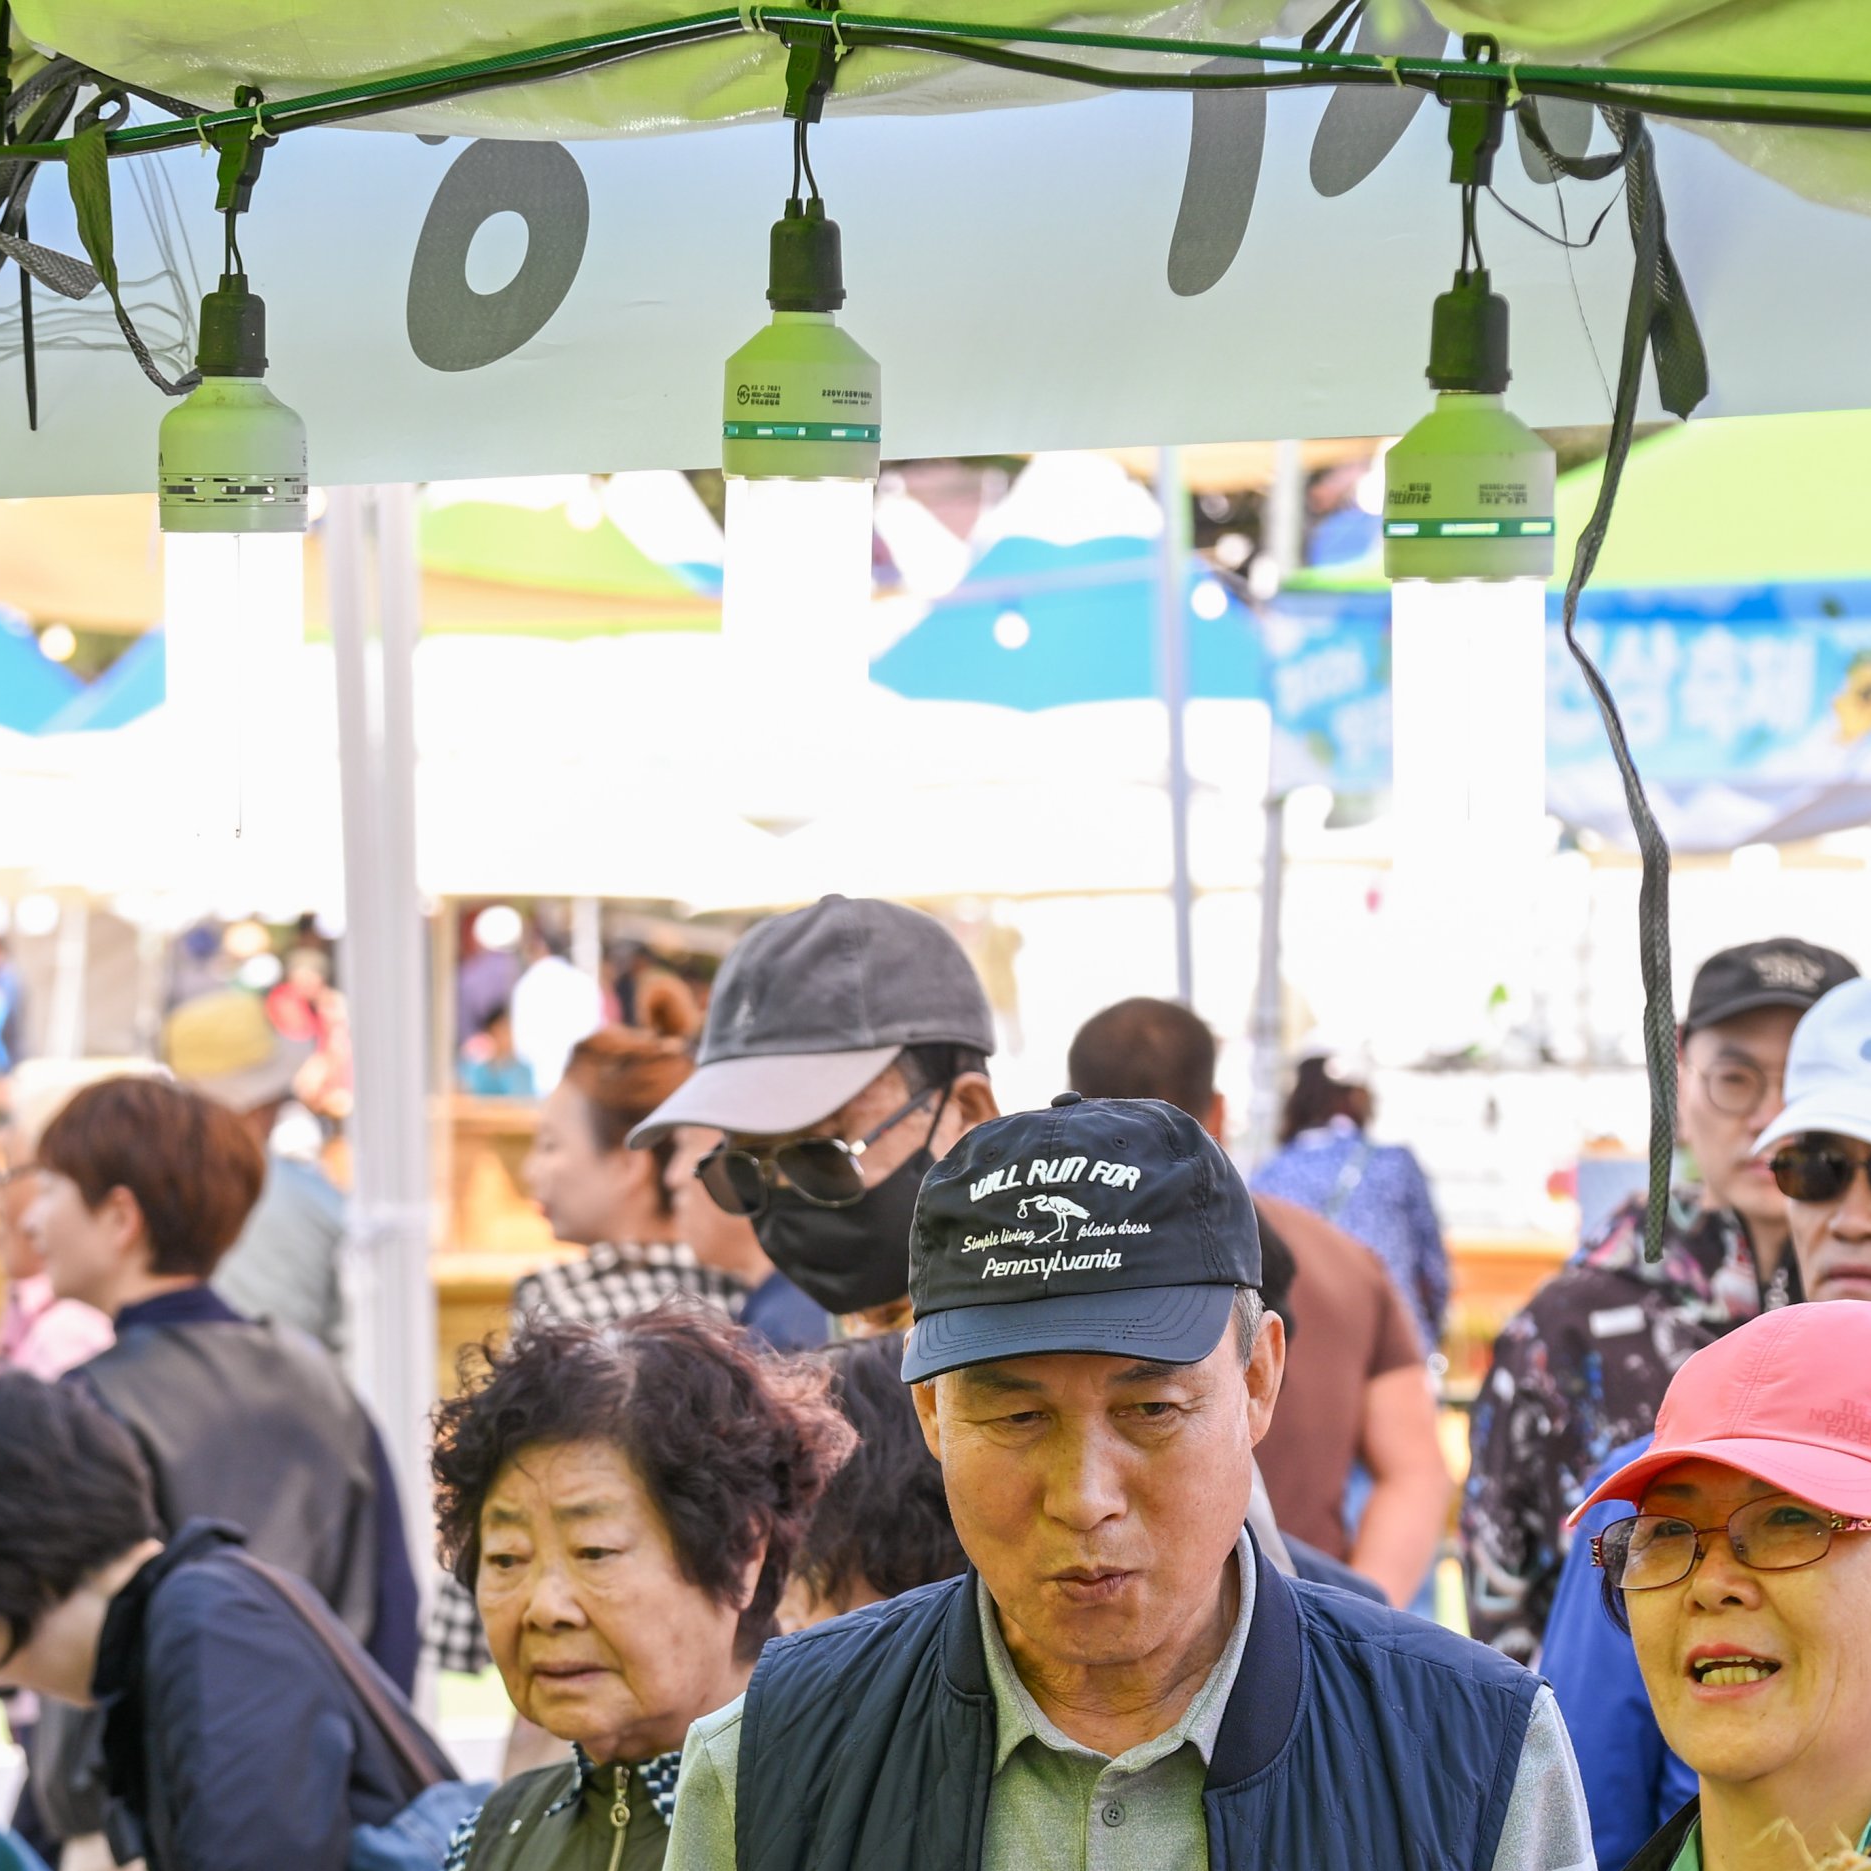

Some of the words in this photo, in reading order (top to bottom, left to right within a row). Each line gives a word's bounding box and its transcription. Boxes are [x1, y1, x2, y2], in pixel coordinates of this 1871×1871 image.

[969, 1164, 1022, 1202] WILL
[1026, 1156, 1088, 1186] RUN
[1088, 1160, 1141, 1192] FOR
[961, 1230, 1000, 1253] Simple
[1000, 1227, 1036, 1246] living
[1077, 1221, 1116, 1241] plain
[1117, 1218, 1152, 1235] dress
[981, 1248, 1122, 1280] Pennsylvania
[1809, 1407, 1871, 1432] NORTH
[1825, 1423, 1871, 1446] FACE
